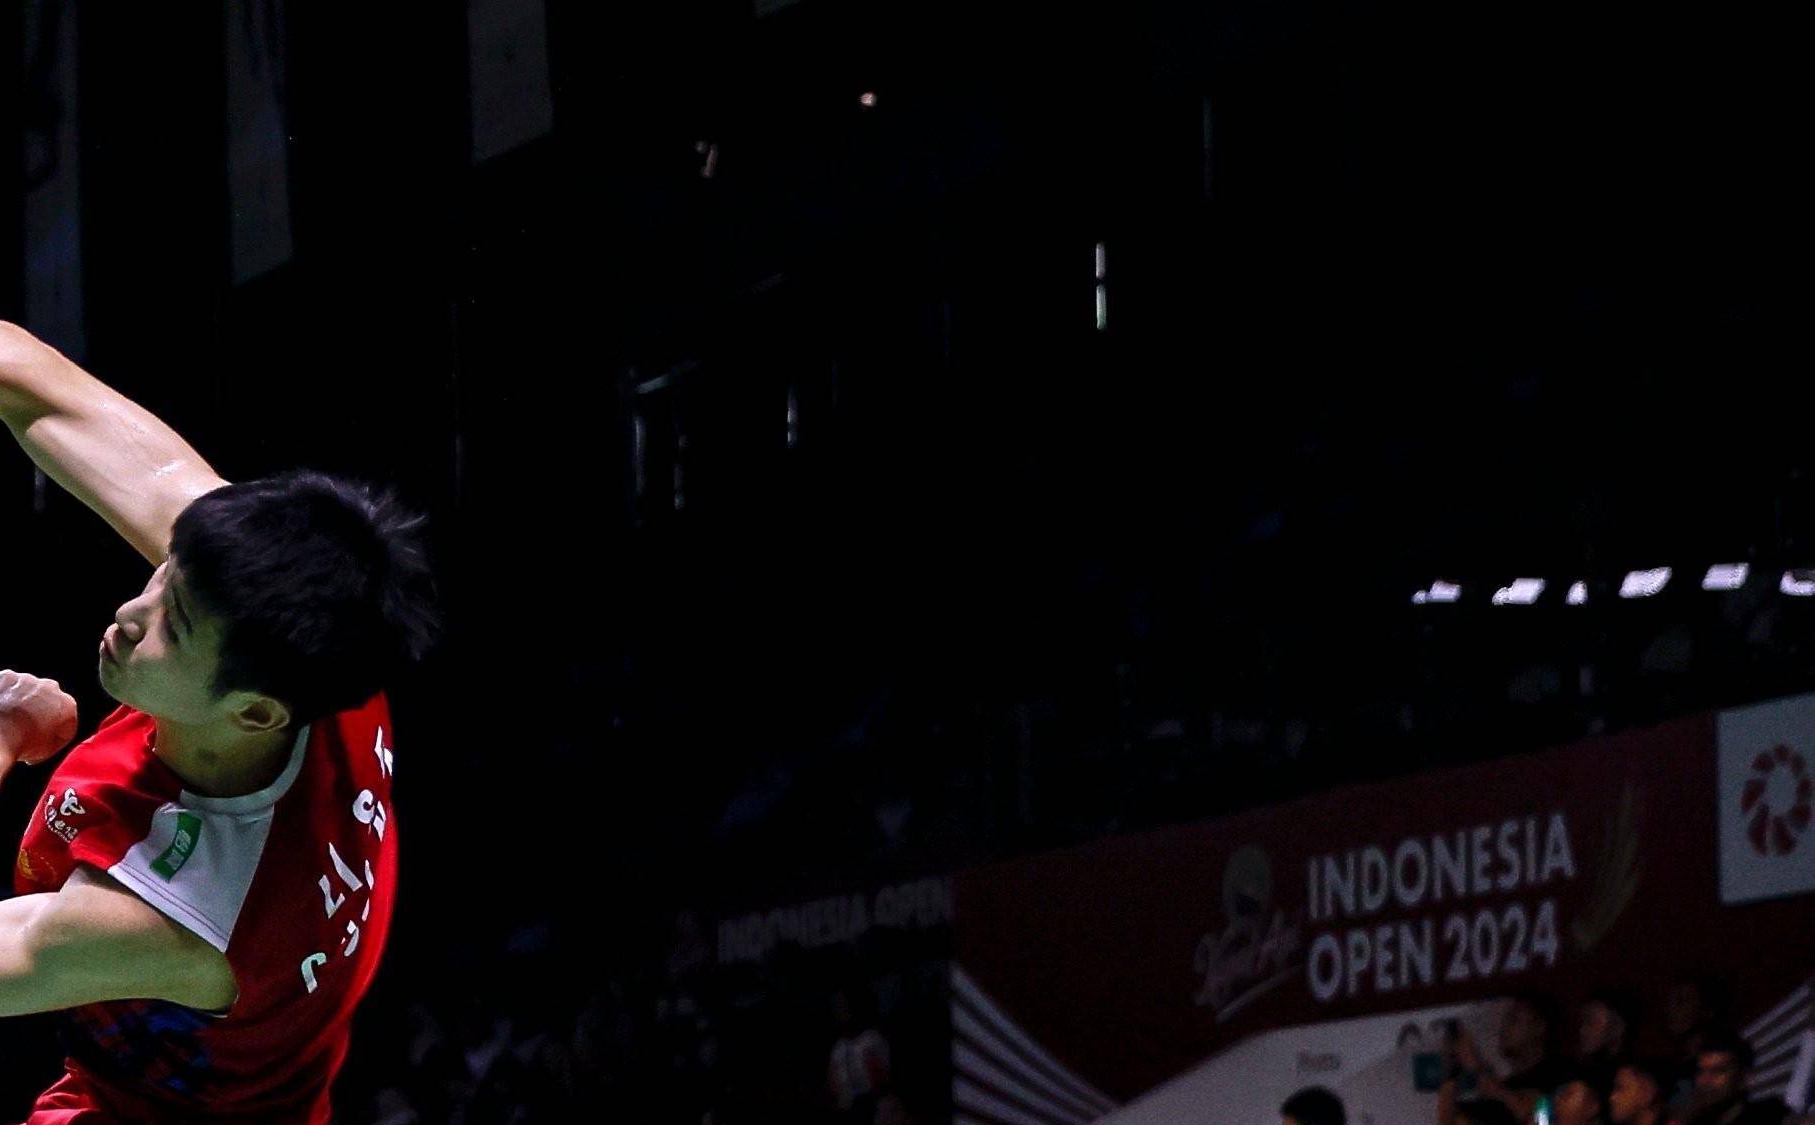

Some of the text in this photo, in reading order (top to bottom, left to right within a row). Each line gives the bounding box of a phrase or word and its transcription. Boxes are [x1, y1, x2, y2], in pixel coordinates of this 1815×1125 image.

[1307, 812, 1576, 920] INDONESIA
[1308, 919, 1433, 1001] OPEN
[1443, 900, 1559, 982] 2024
